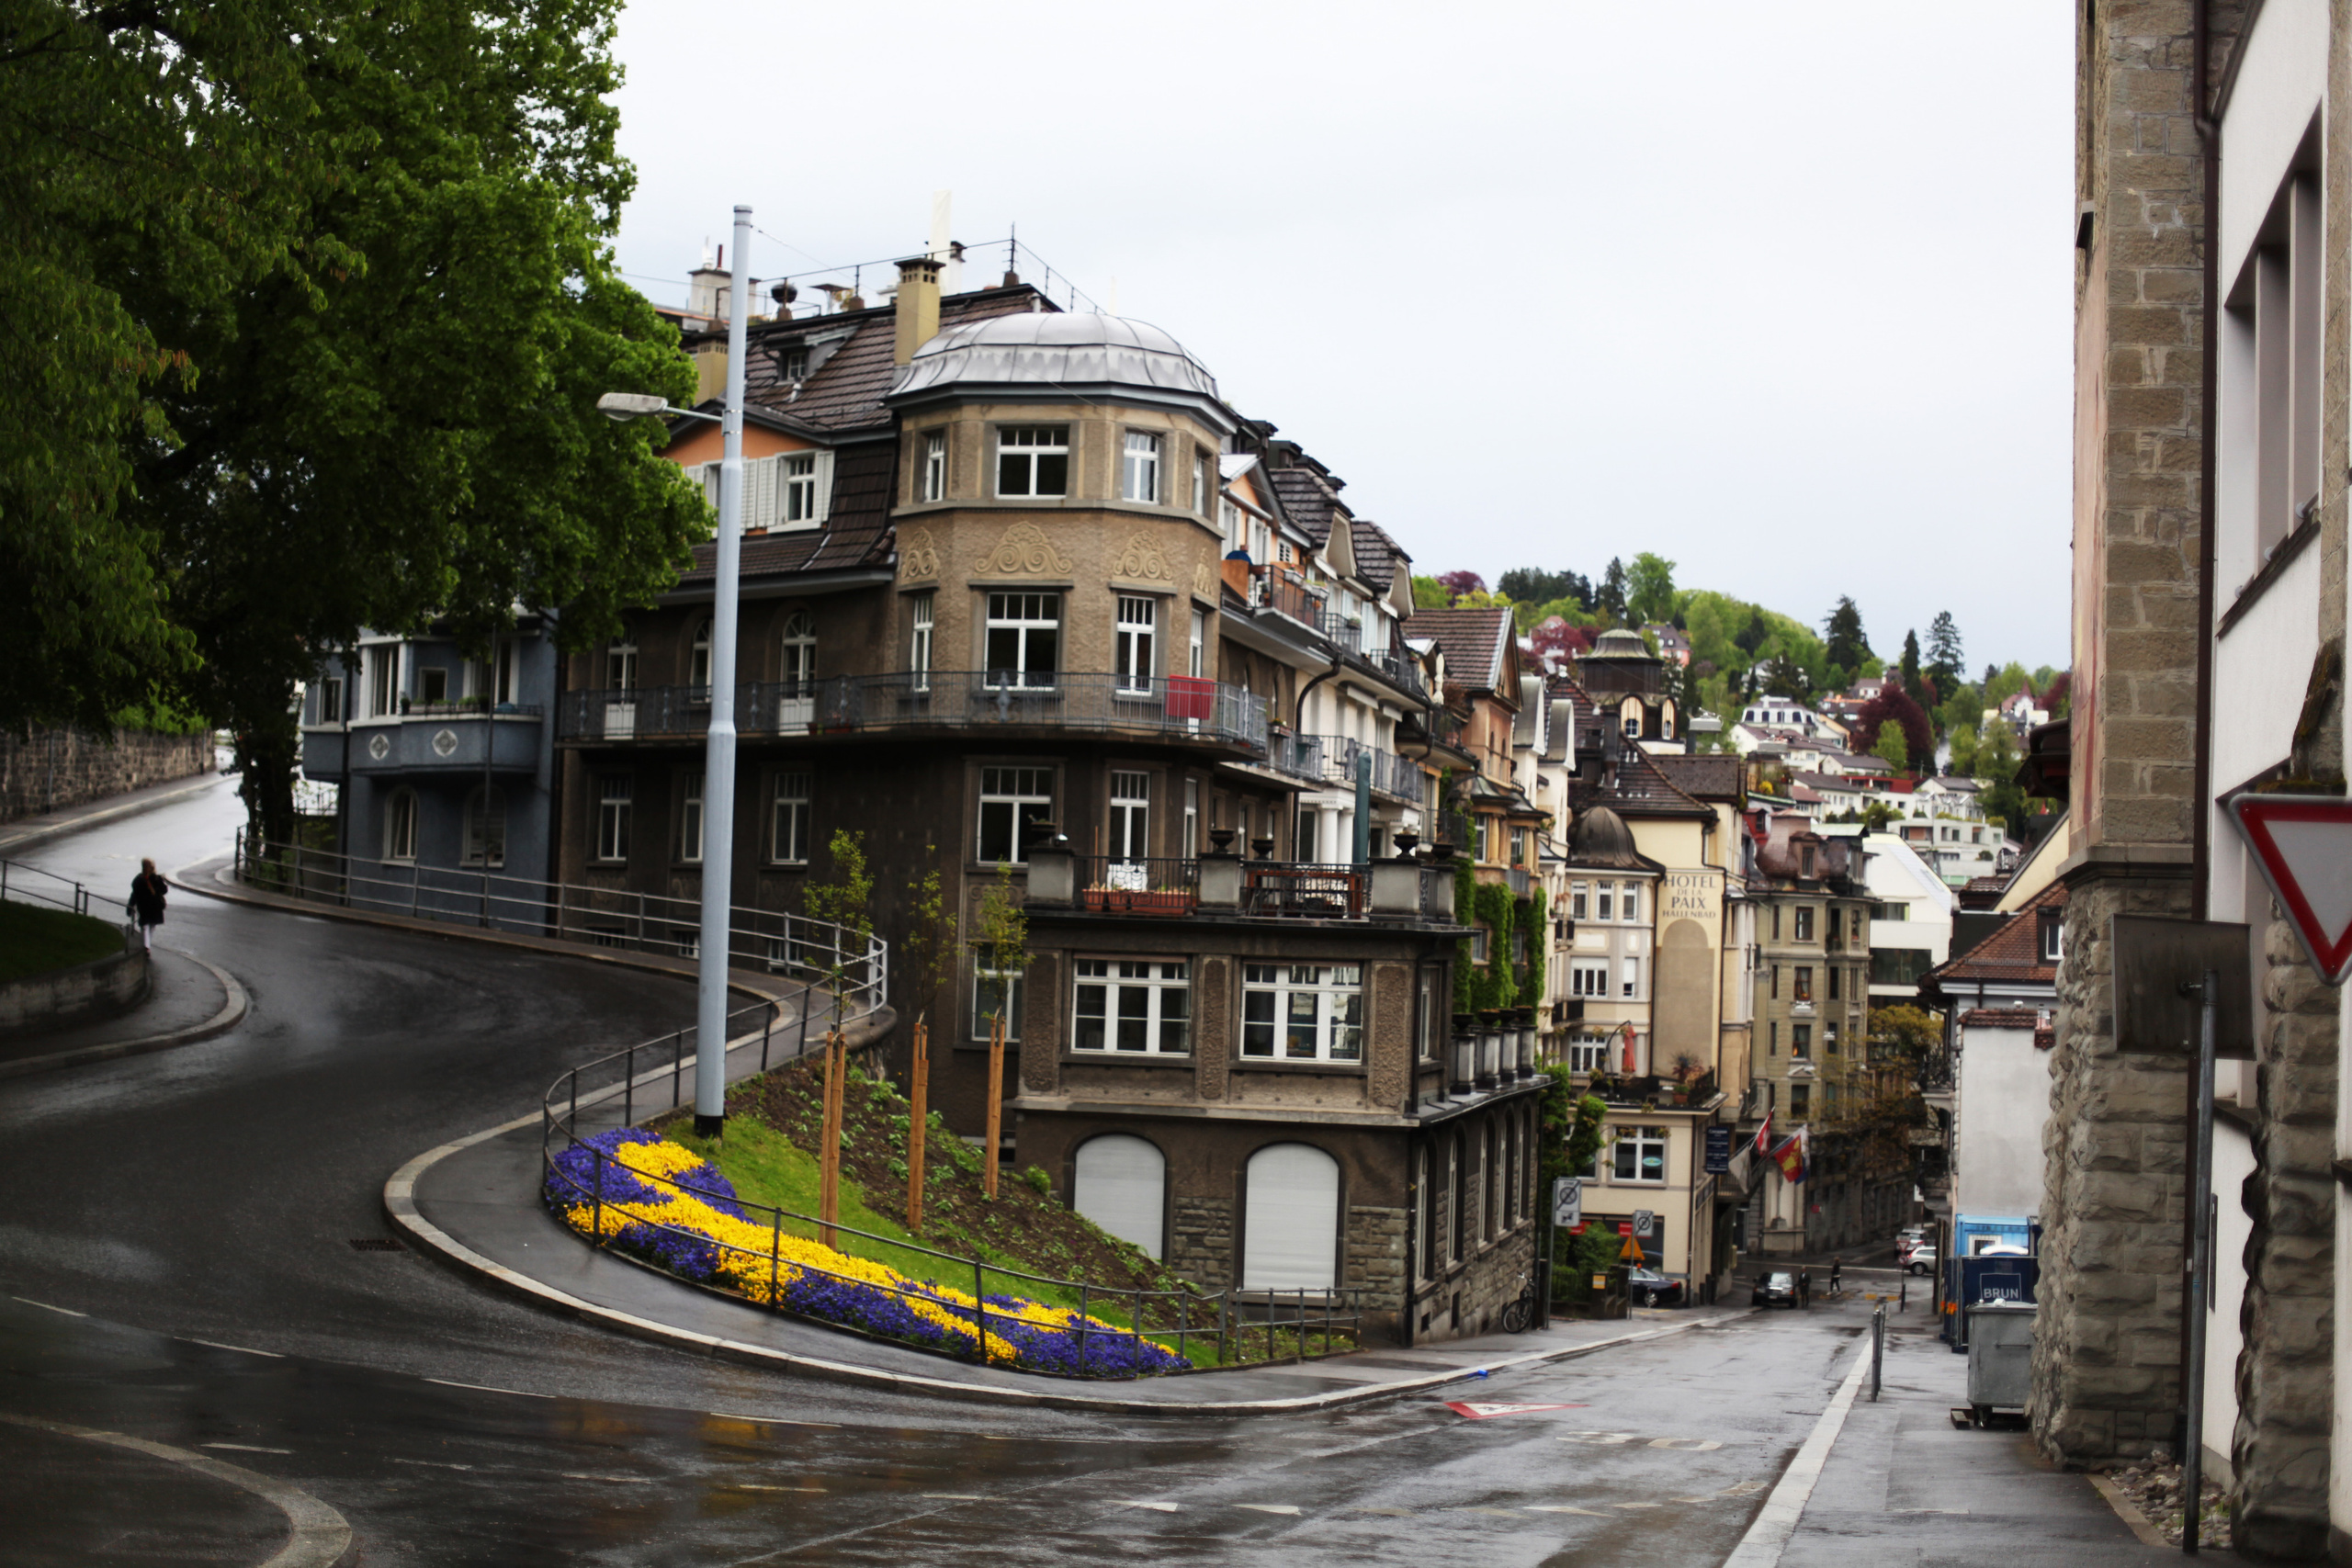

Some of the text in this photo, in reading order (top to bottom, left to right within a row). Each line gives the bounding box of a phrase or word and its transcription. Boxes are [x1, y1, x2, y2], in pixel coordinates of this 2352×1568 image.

[1663, 874, 1716, 888] HOTEL
[1671, 897, 1706, 909] PAIX
[1984, 1288, 2018, 1299] BRUN
